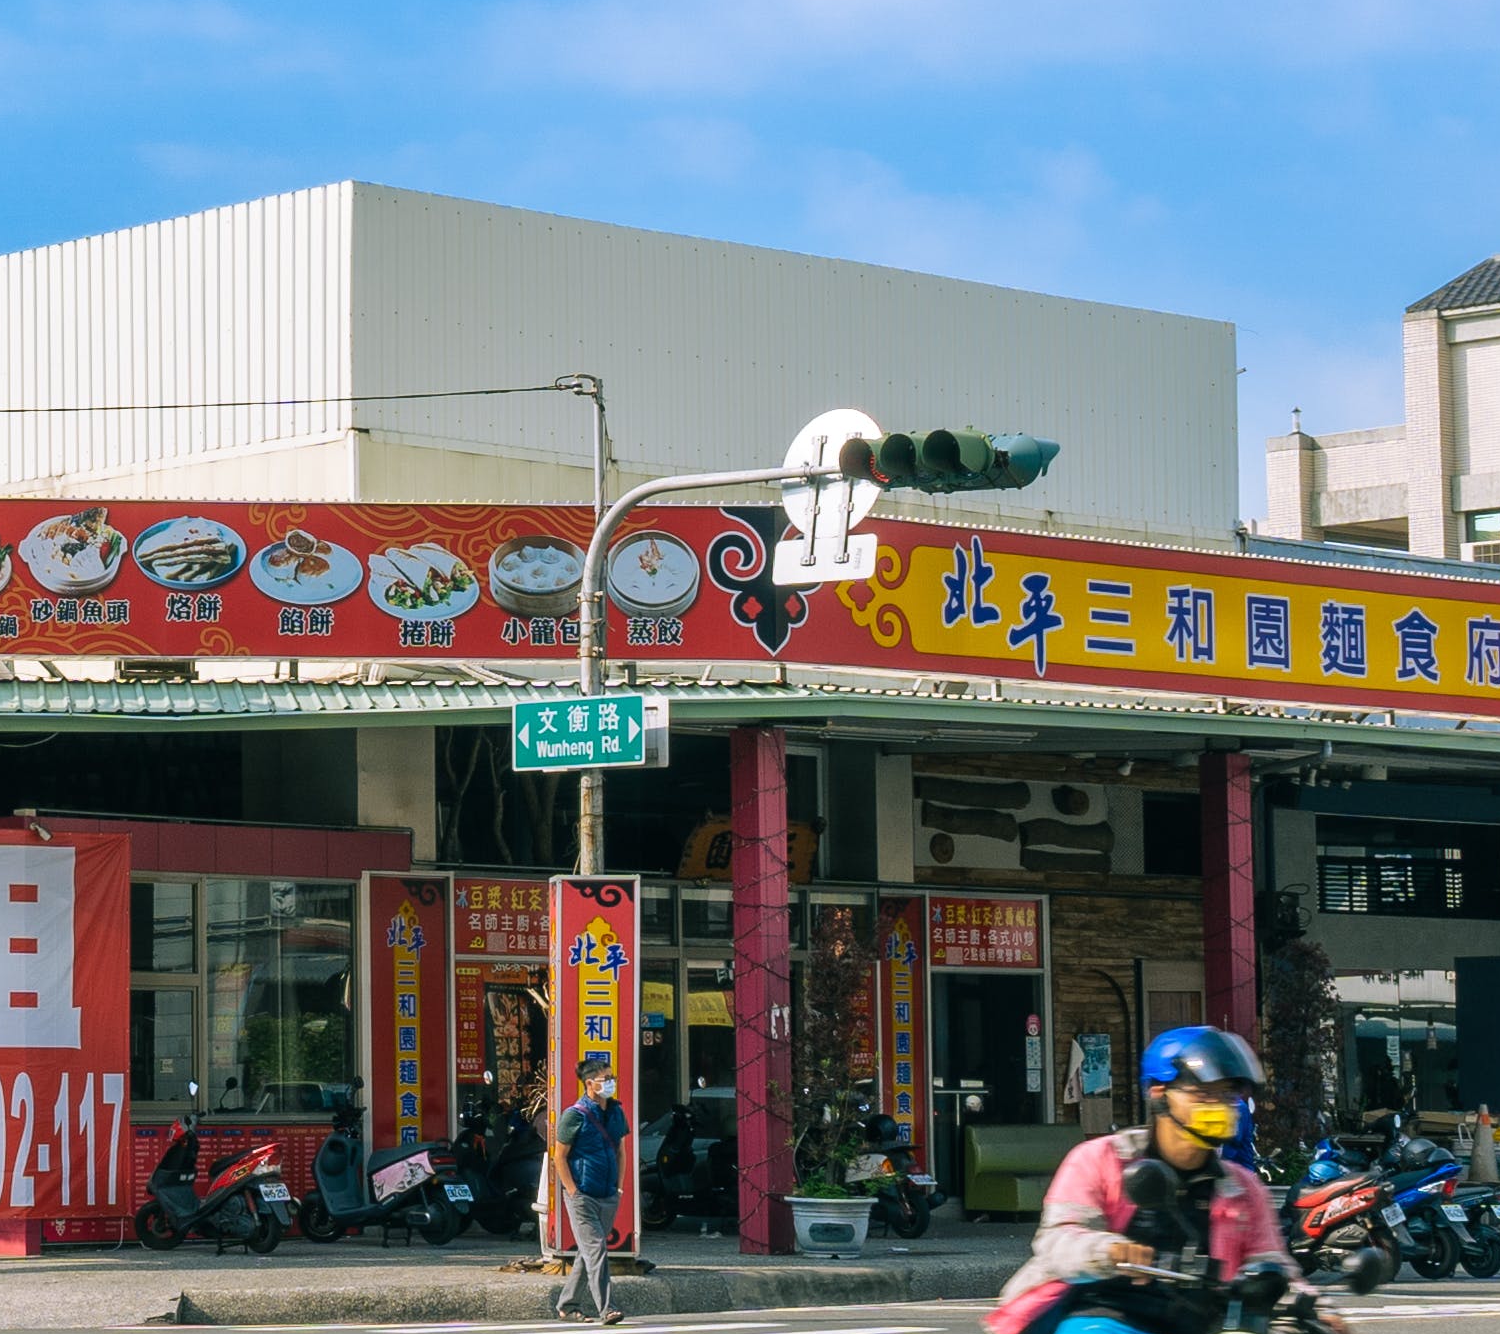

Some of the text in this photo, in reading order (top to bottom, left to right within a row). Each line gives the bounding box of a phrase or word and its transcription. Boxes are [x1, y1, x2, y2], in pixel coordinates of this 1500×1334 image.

[31, 598, 130, 625] 砂鍋魚頭
[166, 593, 222, 623] 烙餅
[278, 607, 335, 637] 餡餅
[400, 618, 454, 648] 捲餅
[501, 618, 581, 648] 小籠包
[627, 618, 683, 647] 蒸餃
[536, 702, 621, 735] 文衡路
[536, 734, 622, 762] Wunheng Rd.
[387, 915, 427, 1148] 北平三和園麵食府
